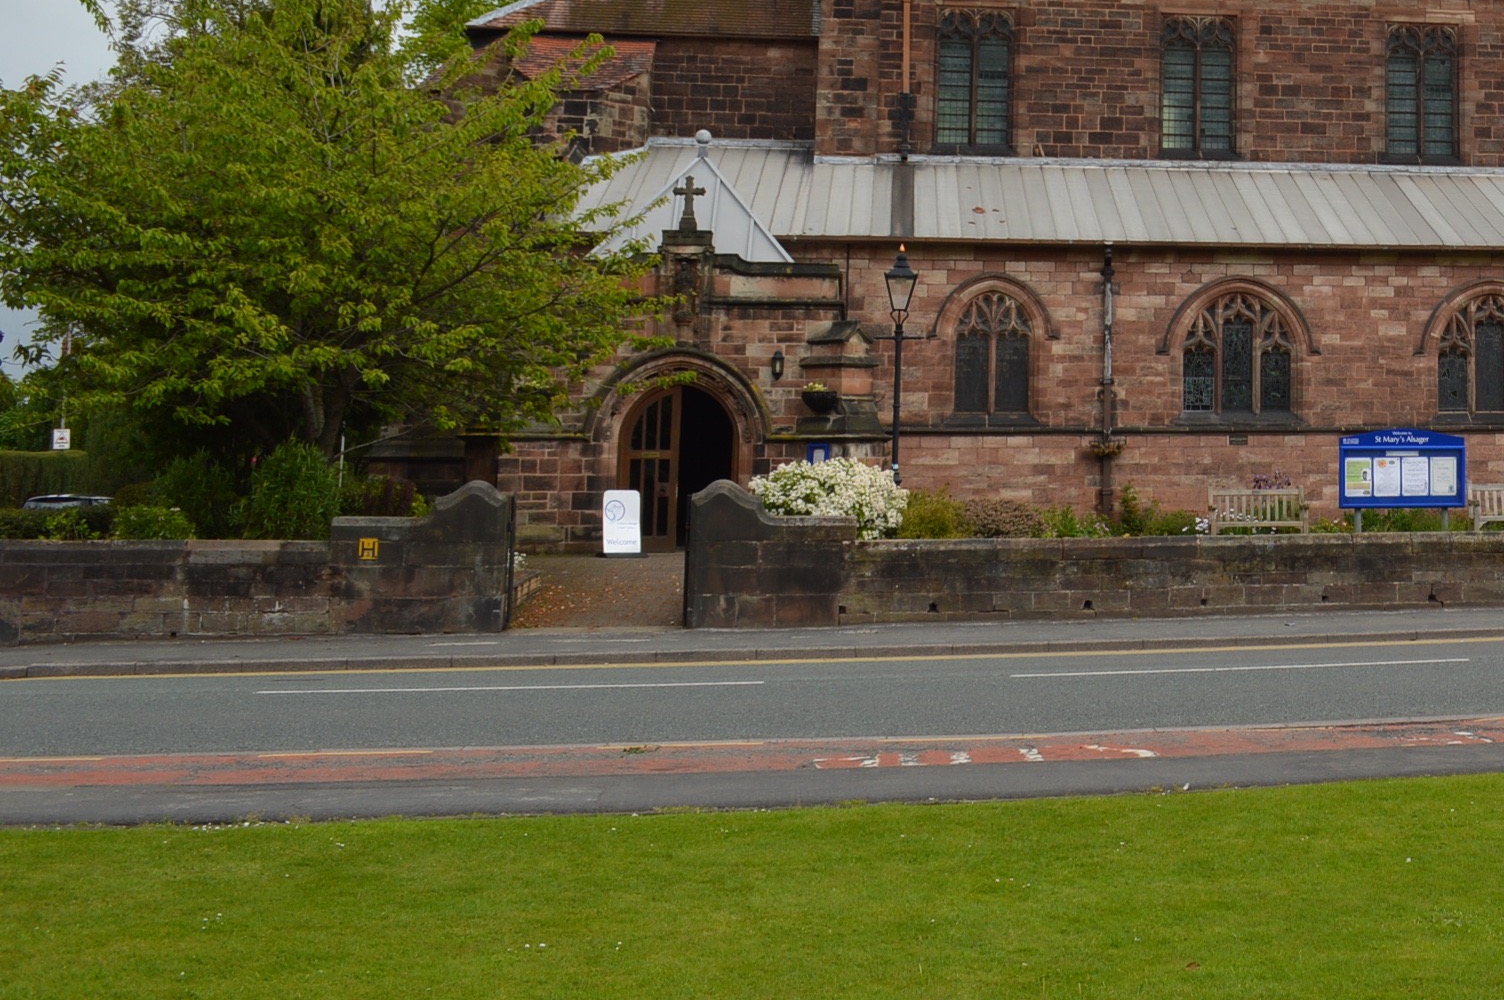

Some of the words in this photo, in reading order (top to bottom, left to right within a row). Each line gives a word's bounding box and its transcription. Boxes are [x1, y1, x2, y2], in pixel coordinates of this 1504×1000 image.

[1383, 435, 1405, 445] Mary's
[1406, 435, 1429, 445] Alsager
[361, 541, 375, 557] H
